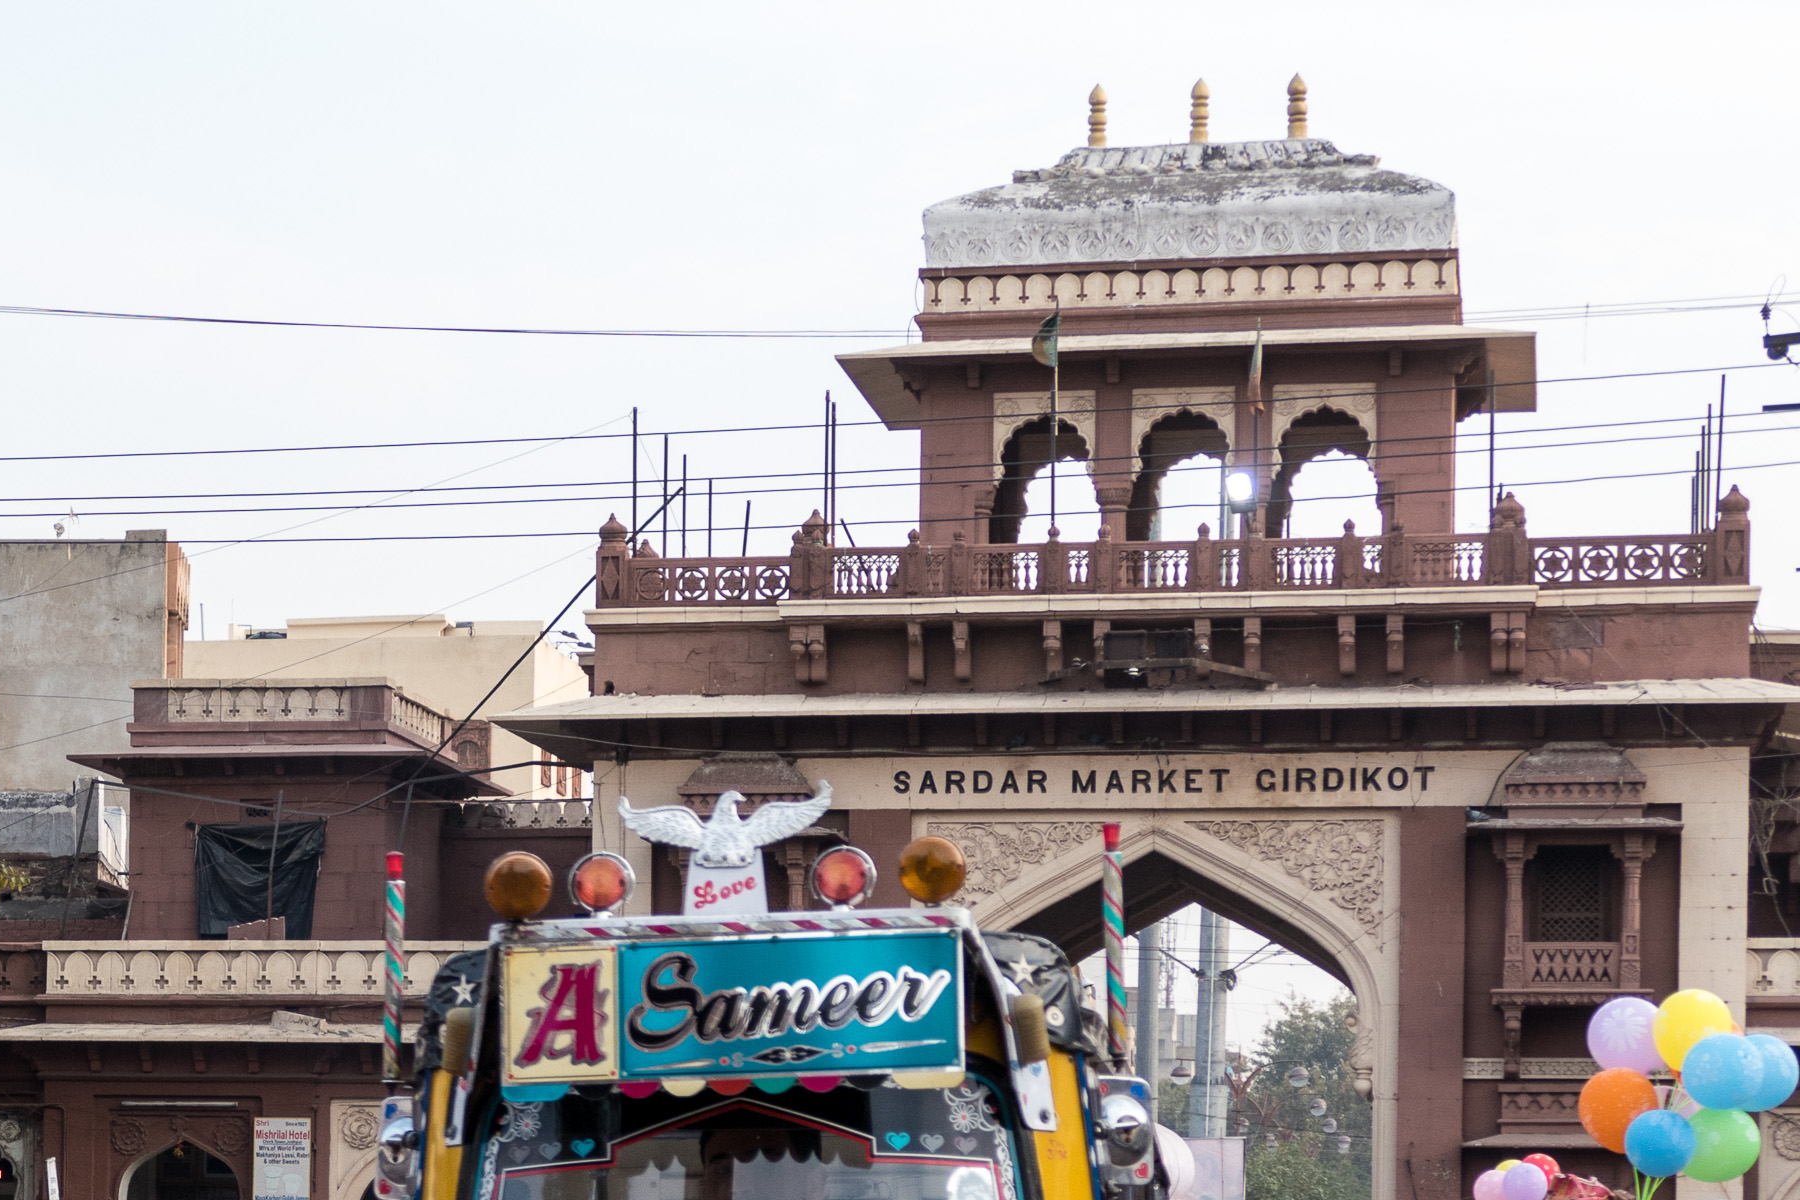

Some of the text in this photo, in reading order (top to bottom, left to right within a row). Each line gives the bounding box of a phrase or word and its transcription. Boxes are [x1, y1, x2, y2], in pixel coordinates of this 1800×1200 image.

[892, 766, 1436, 795] SARDAR MARKET GIRDIKOT
[693, 876, 756, 909] Love
[514, 960, 609, 1068] A
[625, 951, 953, 1052] Sameer
[255, 1130, 310, 1140] Mishrilal Hotel
